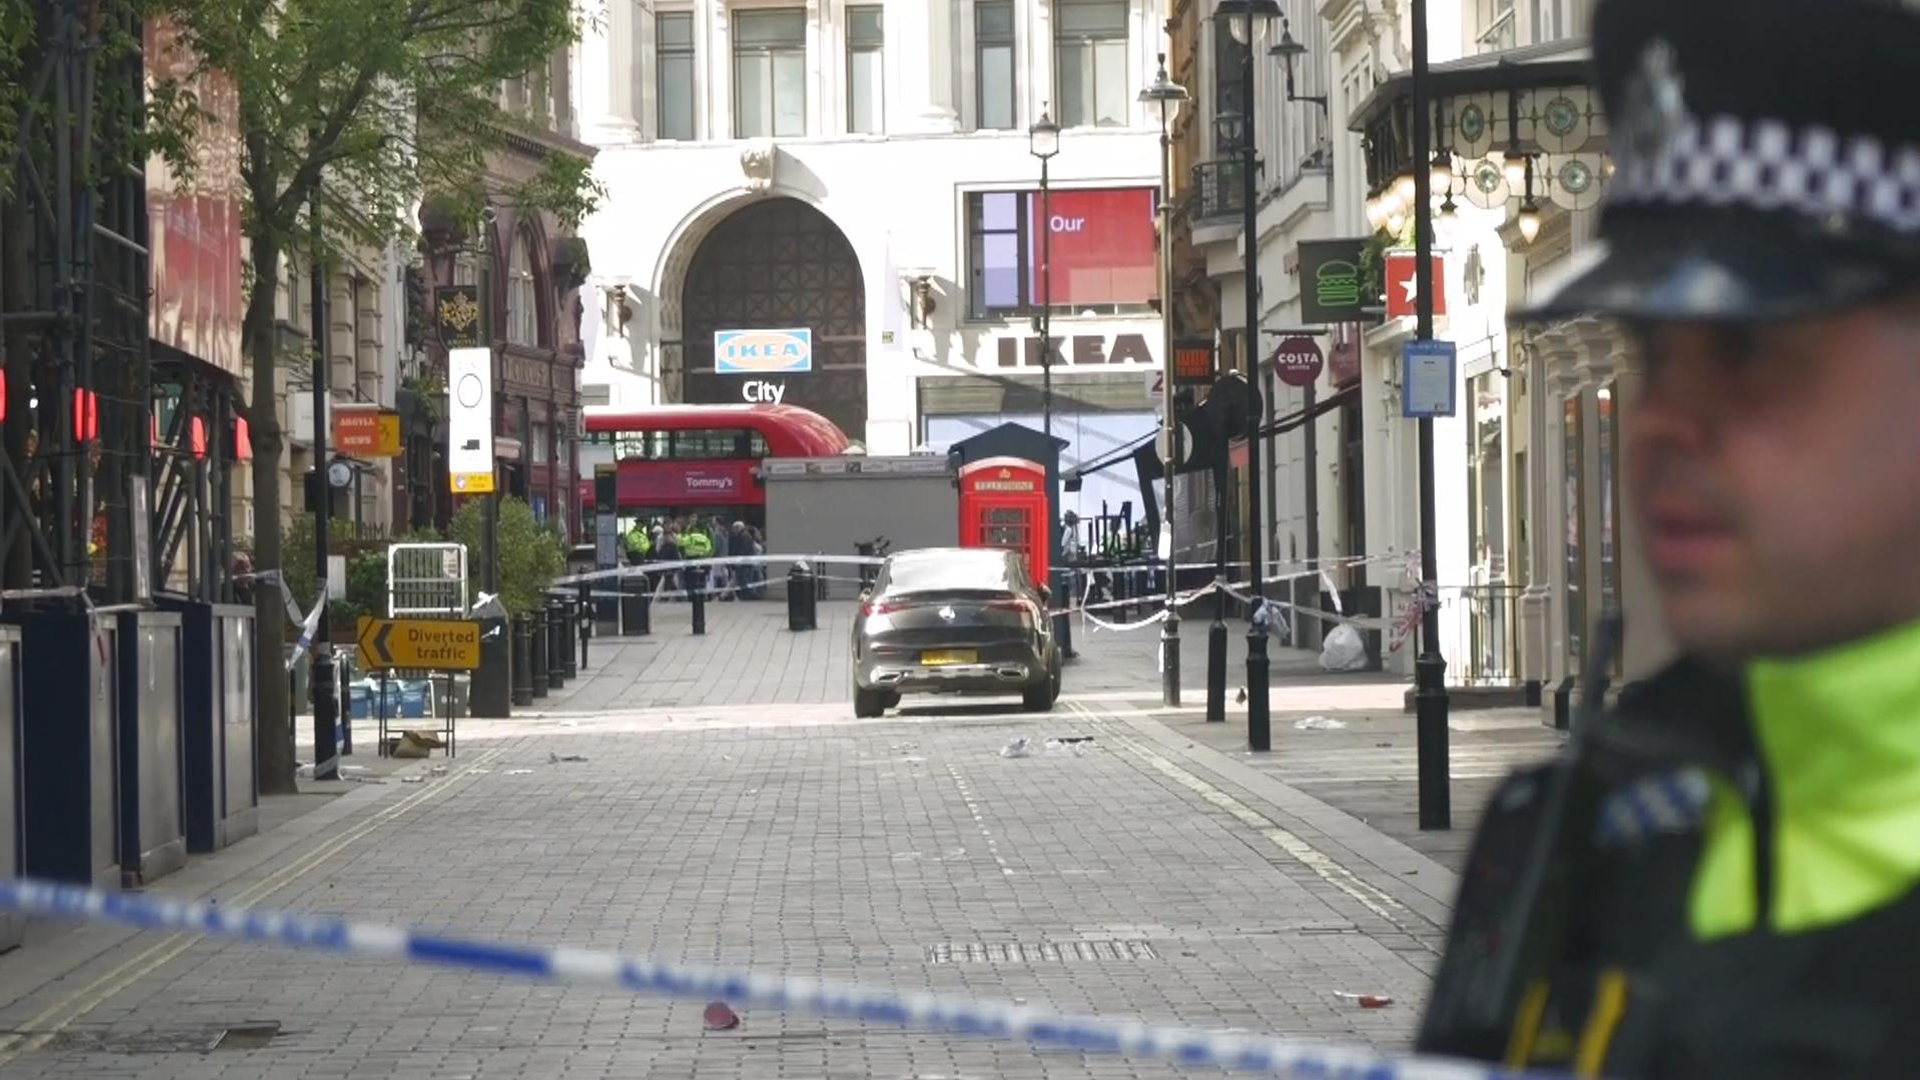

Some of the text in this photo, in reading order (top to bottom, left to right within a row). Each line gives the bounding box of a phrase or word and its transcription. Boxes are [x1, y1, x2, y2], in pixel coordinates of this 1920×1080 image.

[1050, 216, 1084, 232] Our
[727, 343, 799, 358] IKEA
[997, 333, 1154, 367] IKEA
[1278, 353, 1319, 364] COSTA
[742, 380, 786, 406] City
[343, 435, 372, 445] NEWS
[686, 477, 732, 488] Tommy's
[408, 628, 475, 644] Diverted
[417, 647, 466, 660] traffic
